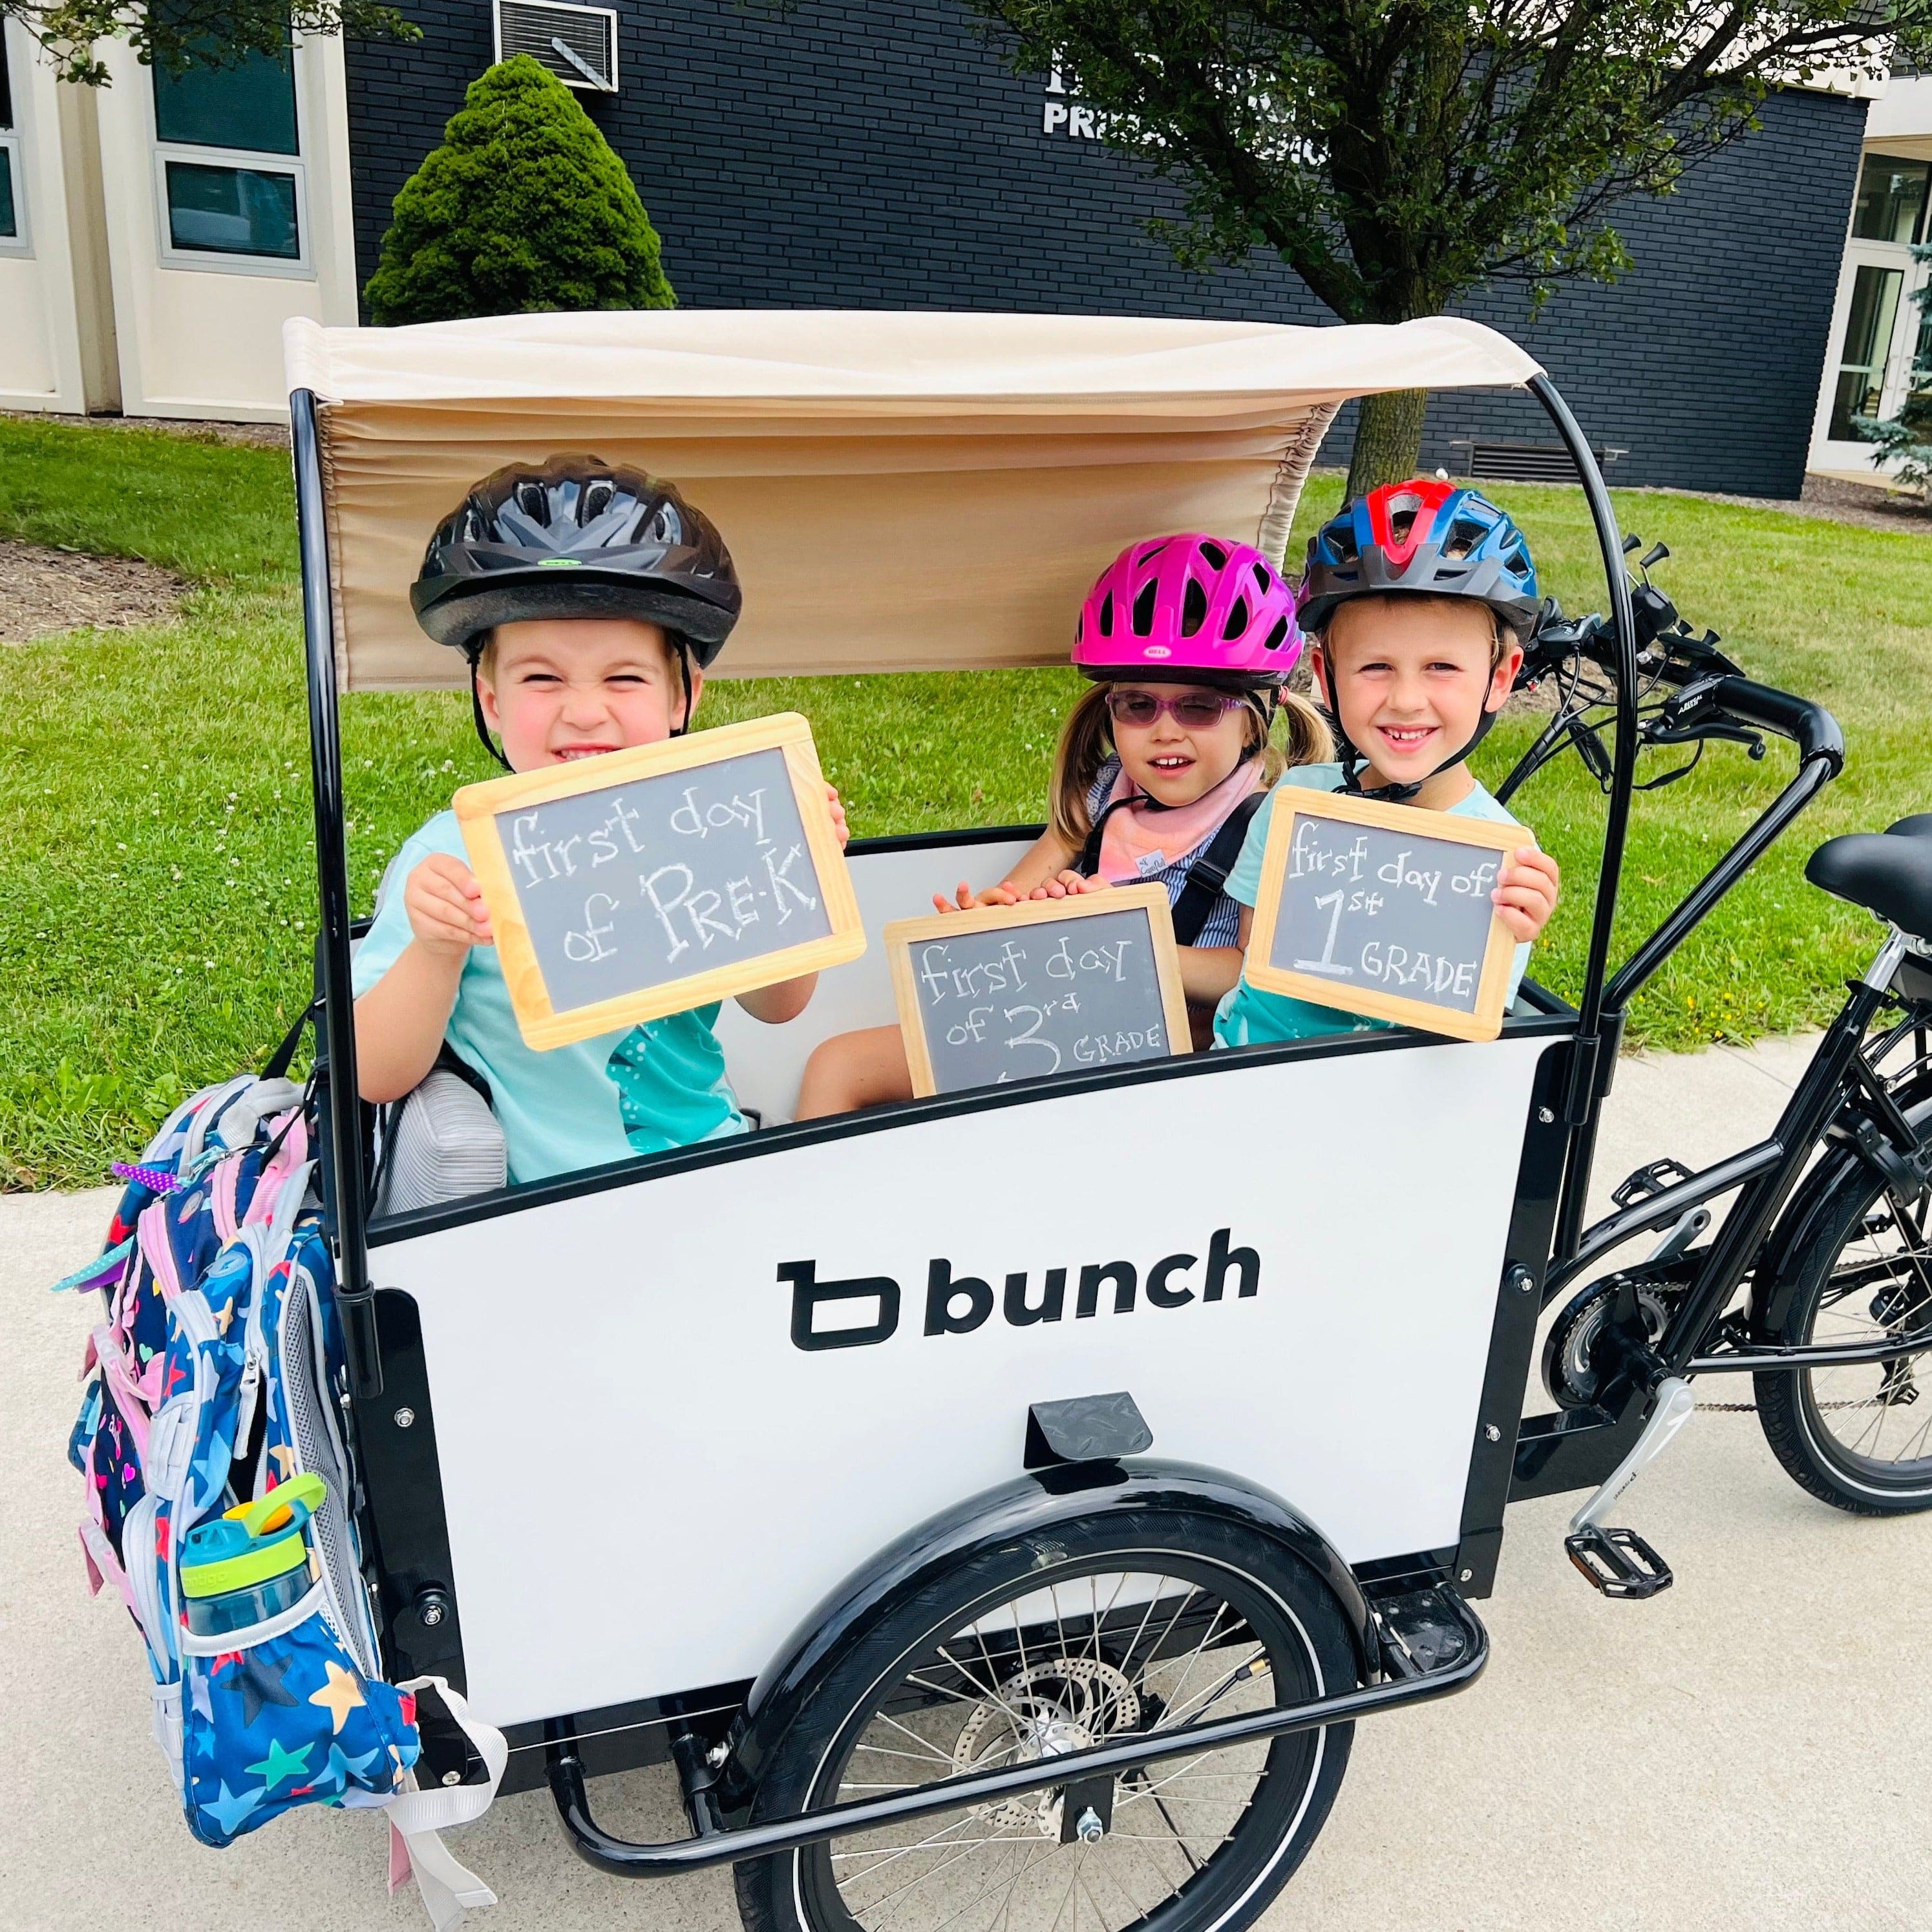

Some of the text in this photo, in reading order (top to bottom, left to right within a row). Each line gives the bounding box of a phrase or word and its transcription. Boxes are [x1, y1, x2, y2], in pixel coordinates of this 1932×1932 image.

[513, 787, 769, 888] first day
[1288, 820, 1498, 906] first day of
[563, 893, 621, 962] of
[920, 936, 1133, 1006] first day
[1293, 889, 1478, 998] 1st GRADE
[946, 992, 1161, 1084] of 3rd GRADE
[923, 1227, 1260, 1337] bunch
